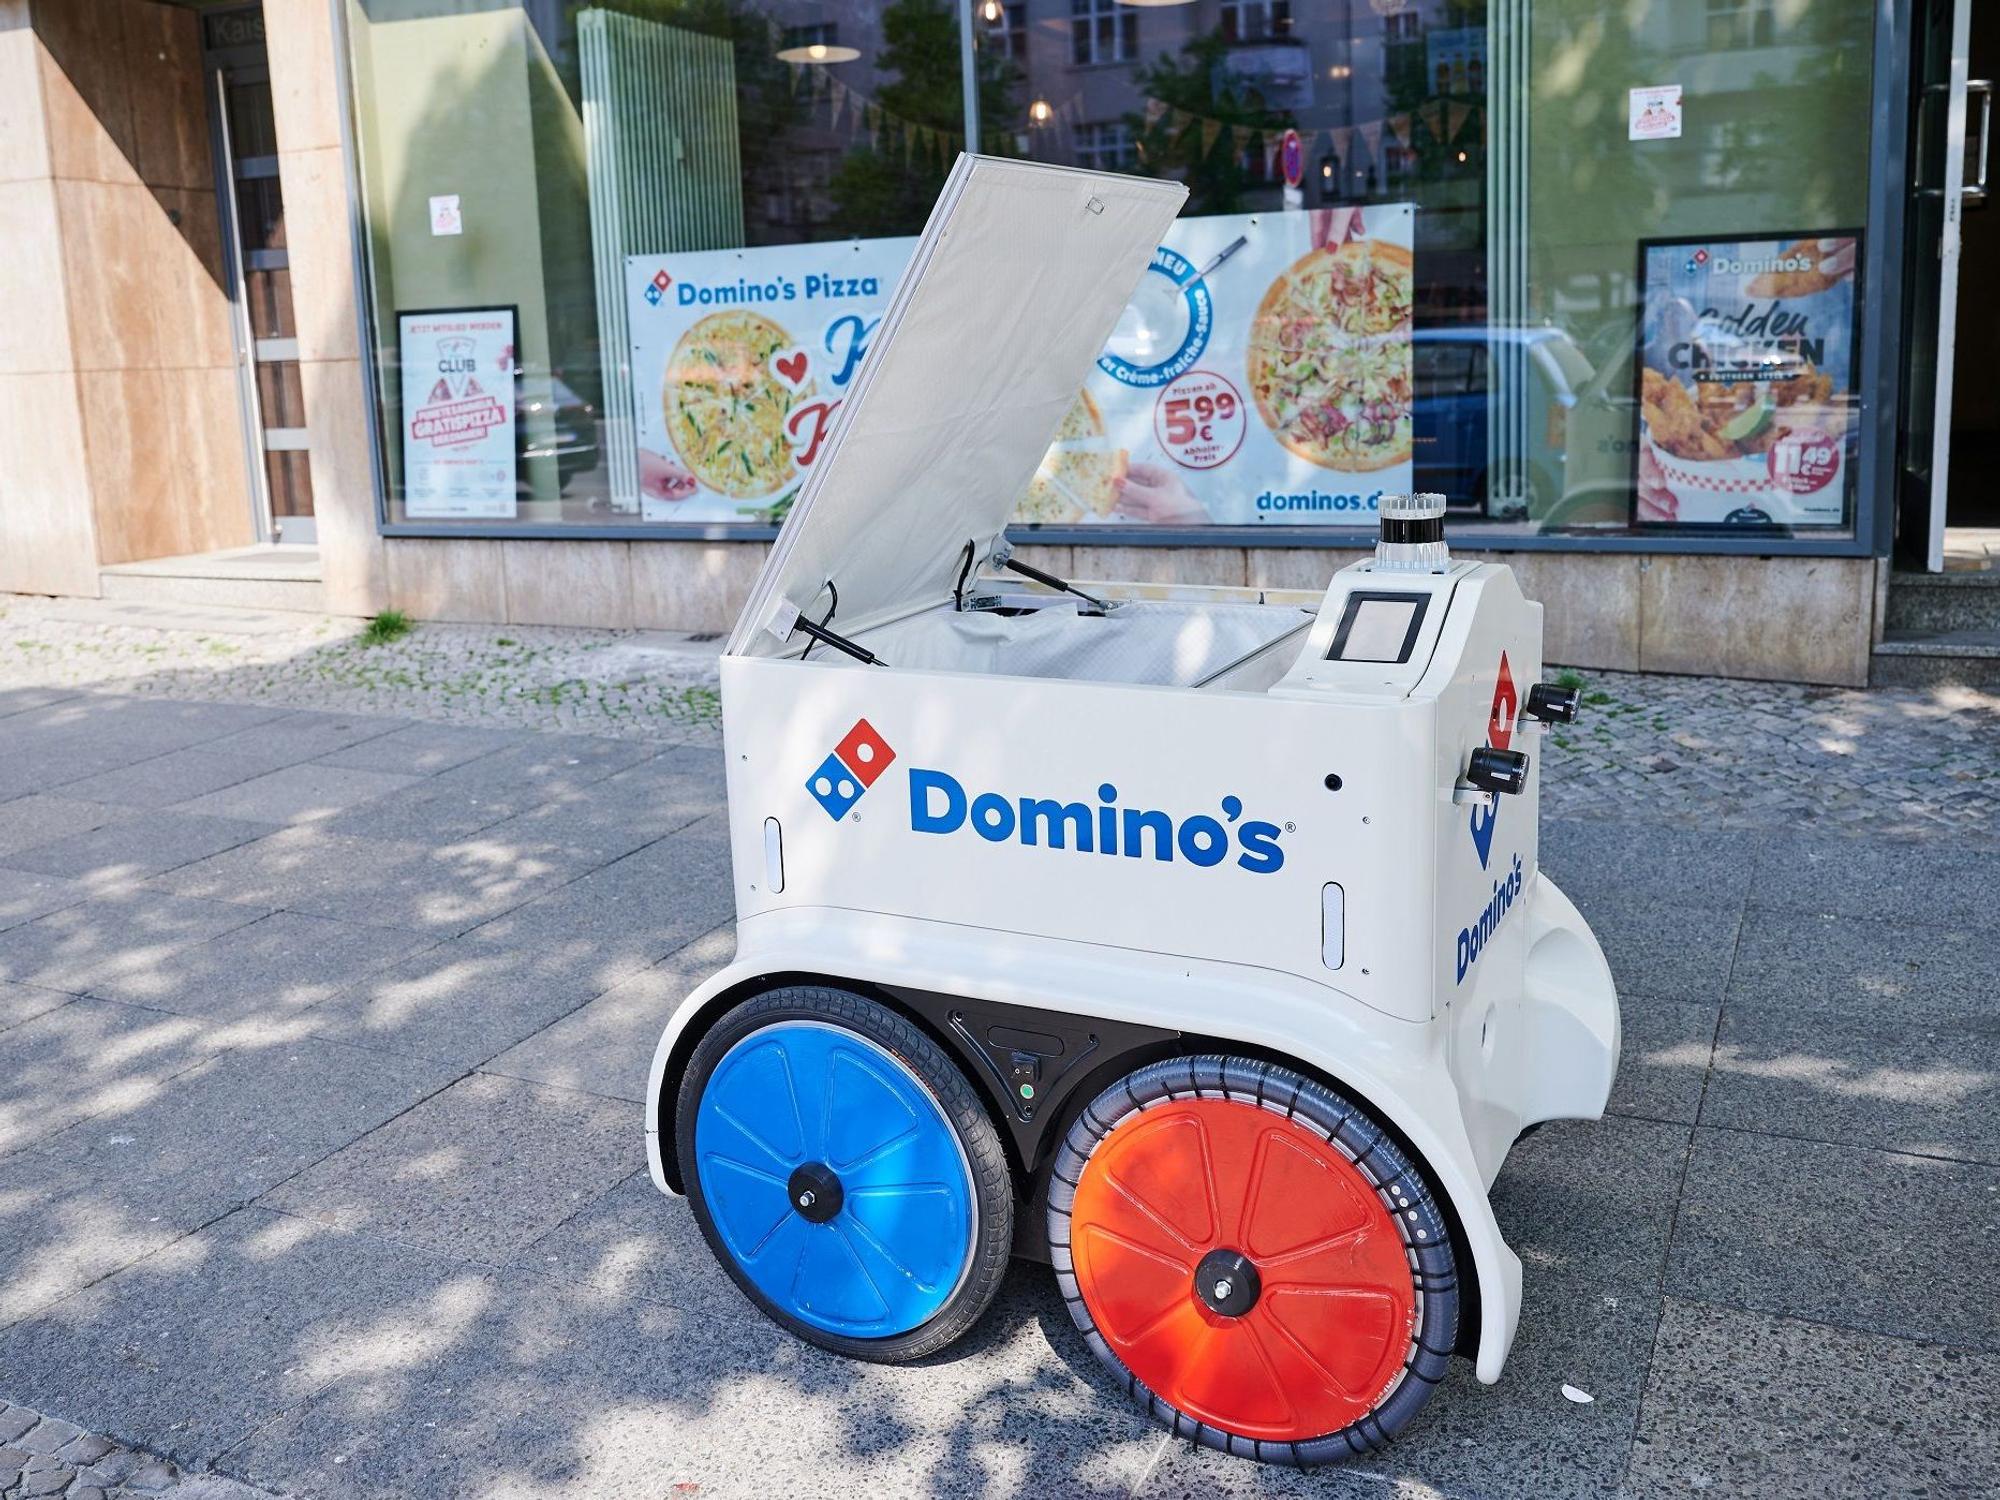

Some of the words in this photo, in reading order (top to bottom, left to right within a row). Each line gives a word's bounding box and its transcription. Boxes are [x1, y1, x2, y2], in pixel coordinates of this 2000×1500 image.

[1712, 253, 1812, 274] Domino's
[678, 276, 796, 305] Domino's
[805, 273, 878, 299] Pizza
[438, 359, 477, 373] CLUB
[908, 767, 1286, 875] Domino's
[1457, 852, 1522, 986] Domino's
